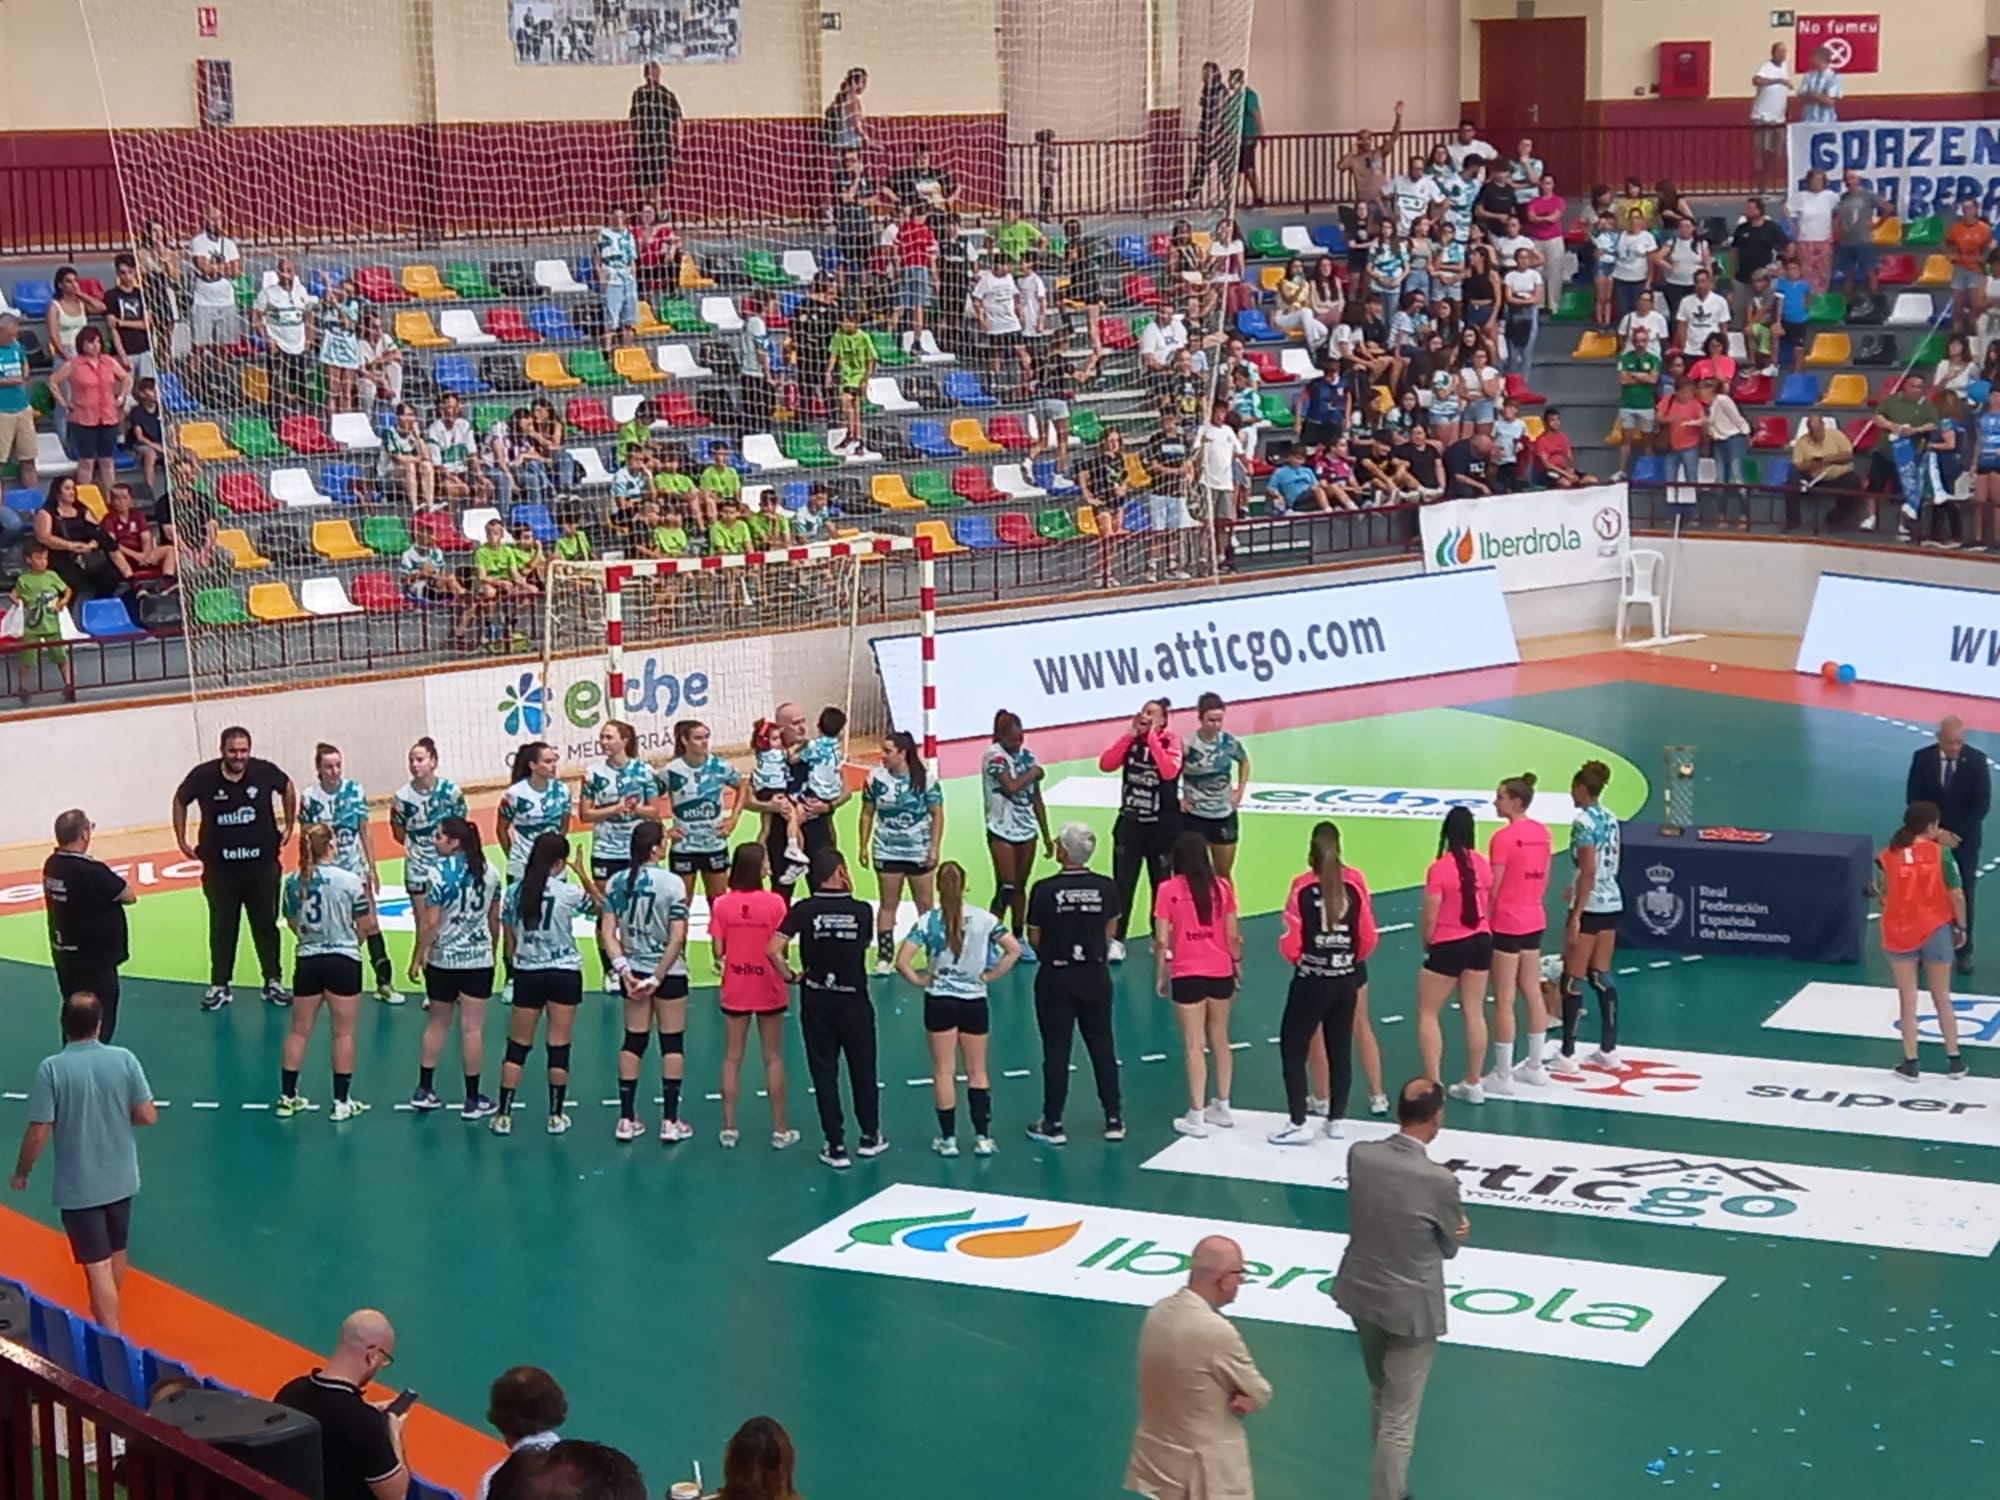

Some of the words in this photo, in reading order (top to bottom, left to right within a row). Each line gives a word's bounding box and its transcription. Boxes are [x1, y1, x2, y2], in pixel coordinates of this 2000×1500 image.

[1799, 20, 1821, 34] No
[1479, 524, 1582, 560] Iberdrola
[1033, 613, 1387, 696] www.atticgo.com
[1250, 788, 1489, 808] elche
[1699, 885, 1728, 898] Real
[1699, 900, 1769, 914] Federación
[1699, 915, 1756, 928] Española
[1699, 928, 1716, 940] de
[1717, 929, 1791, 943] Balonmano
[1746, 1085, 1987, 1115] super
[1540, 1198, 1619, 1213] HOME
